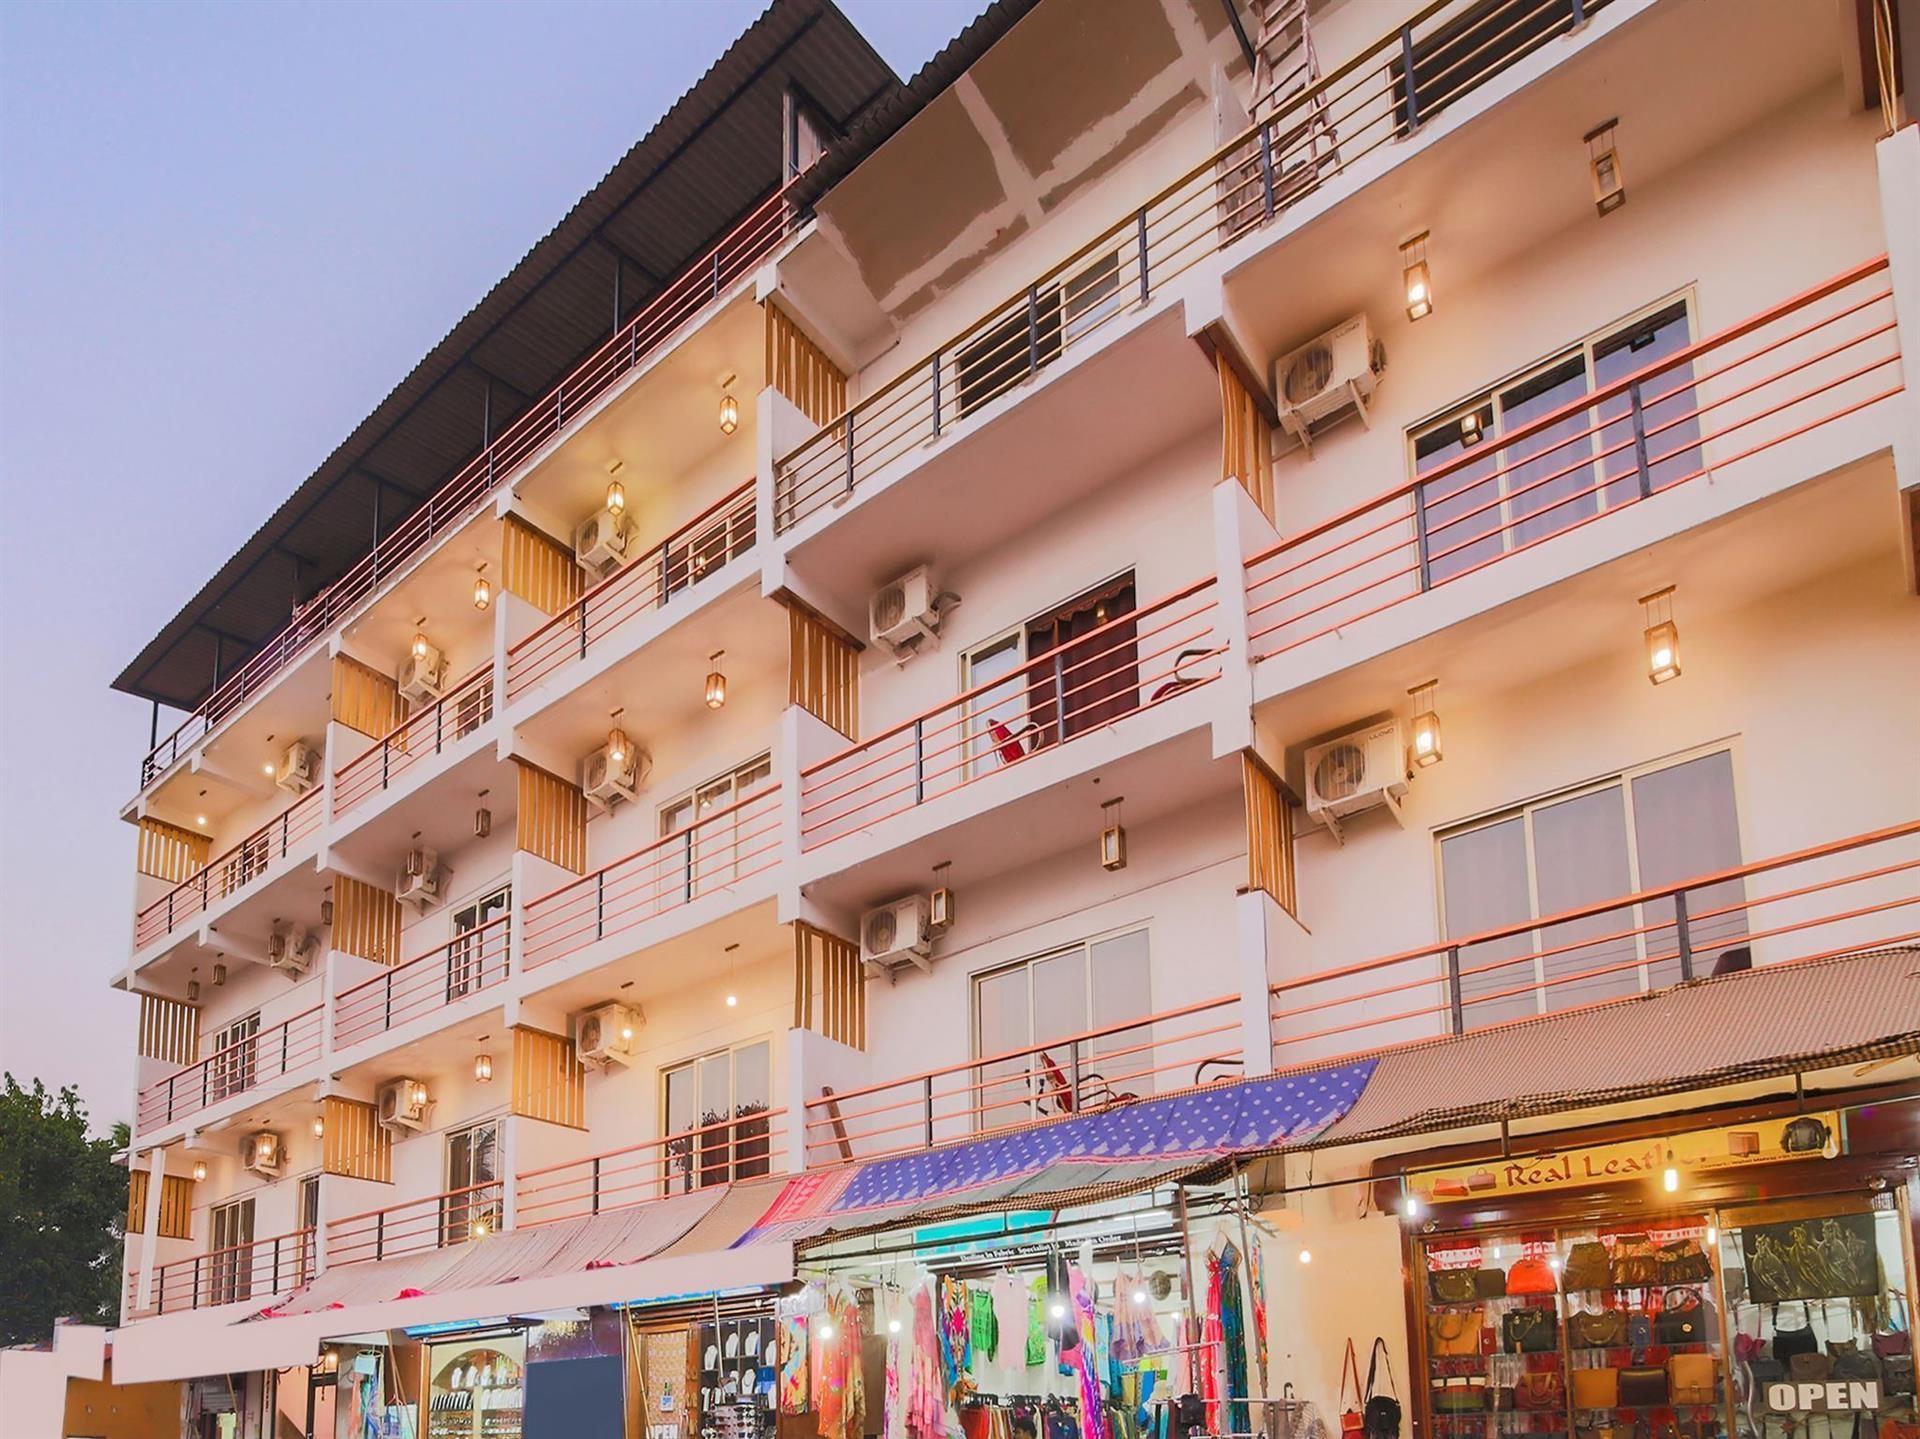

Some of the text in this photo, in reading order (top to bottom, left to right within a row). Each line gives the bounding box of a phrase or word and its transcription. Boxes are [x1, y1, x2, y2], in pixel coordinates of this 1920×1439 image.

[1504, 1155, 1572, 1187] Real
[1582, 1144, 1708, 1177] Leat
[1018, 1243, 1050, 1255] Specialist
[1099, 1234, 1122, 1244] Order
[1768, 1381, 1879, 1411] OPEN
